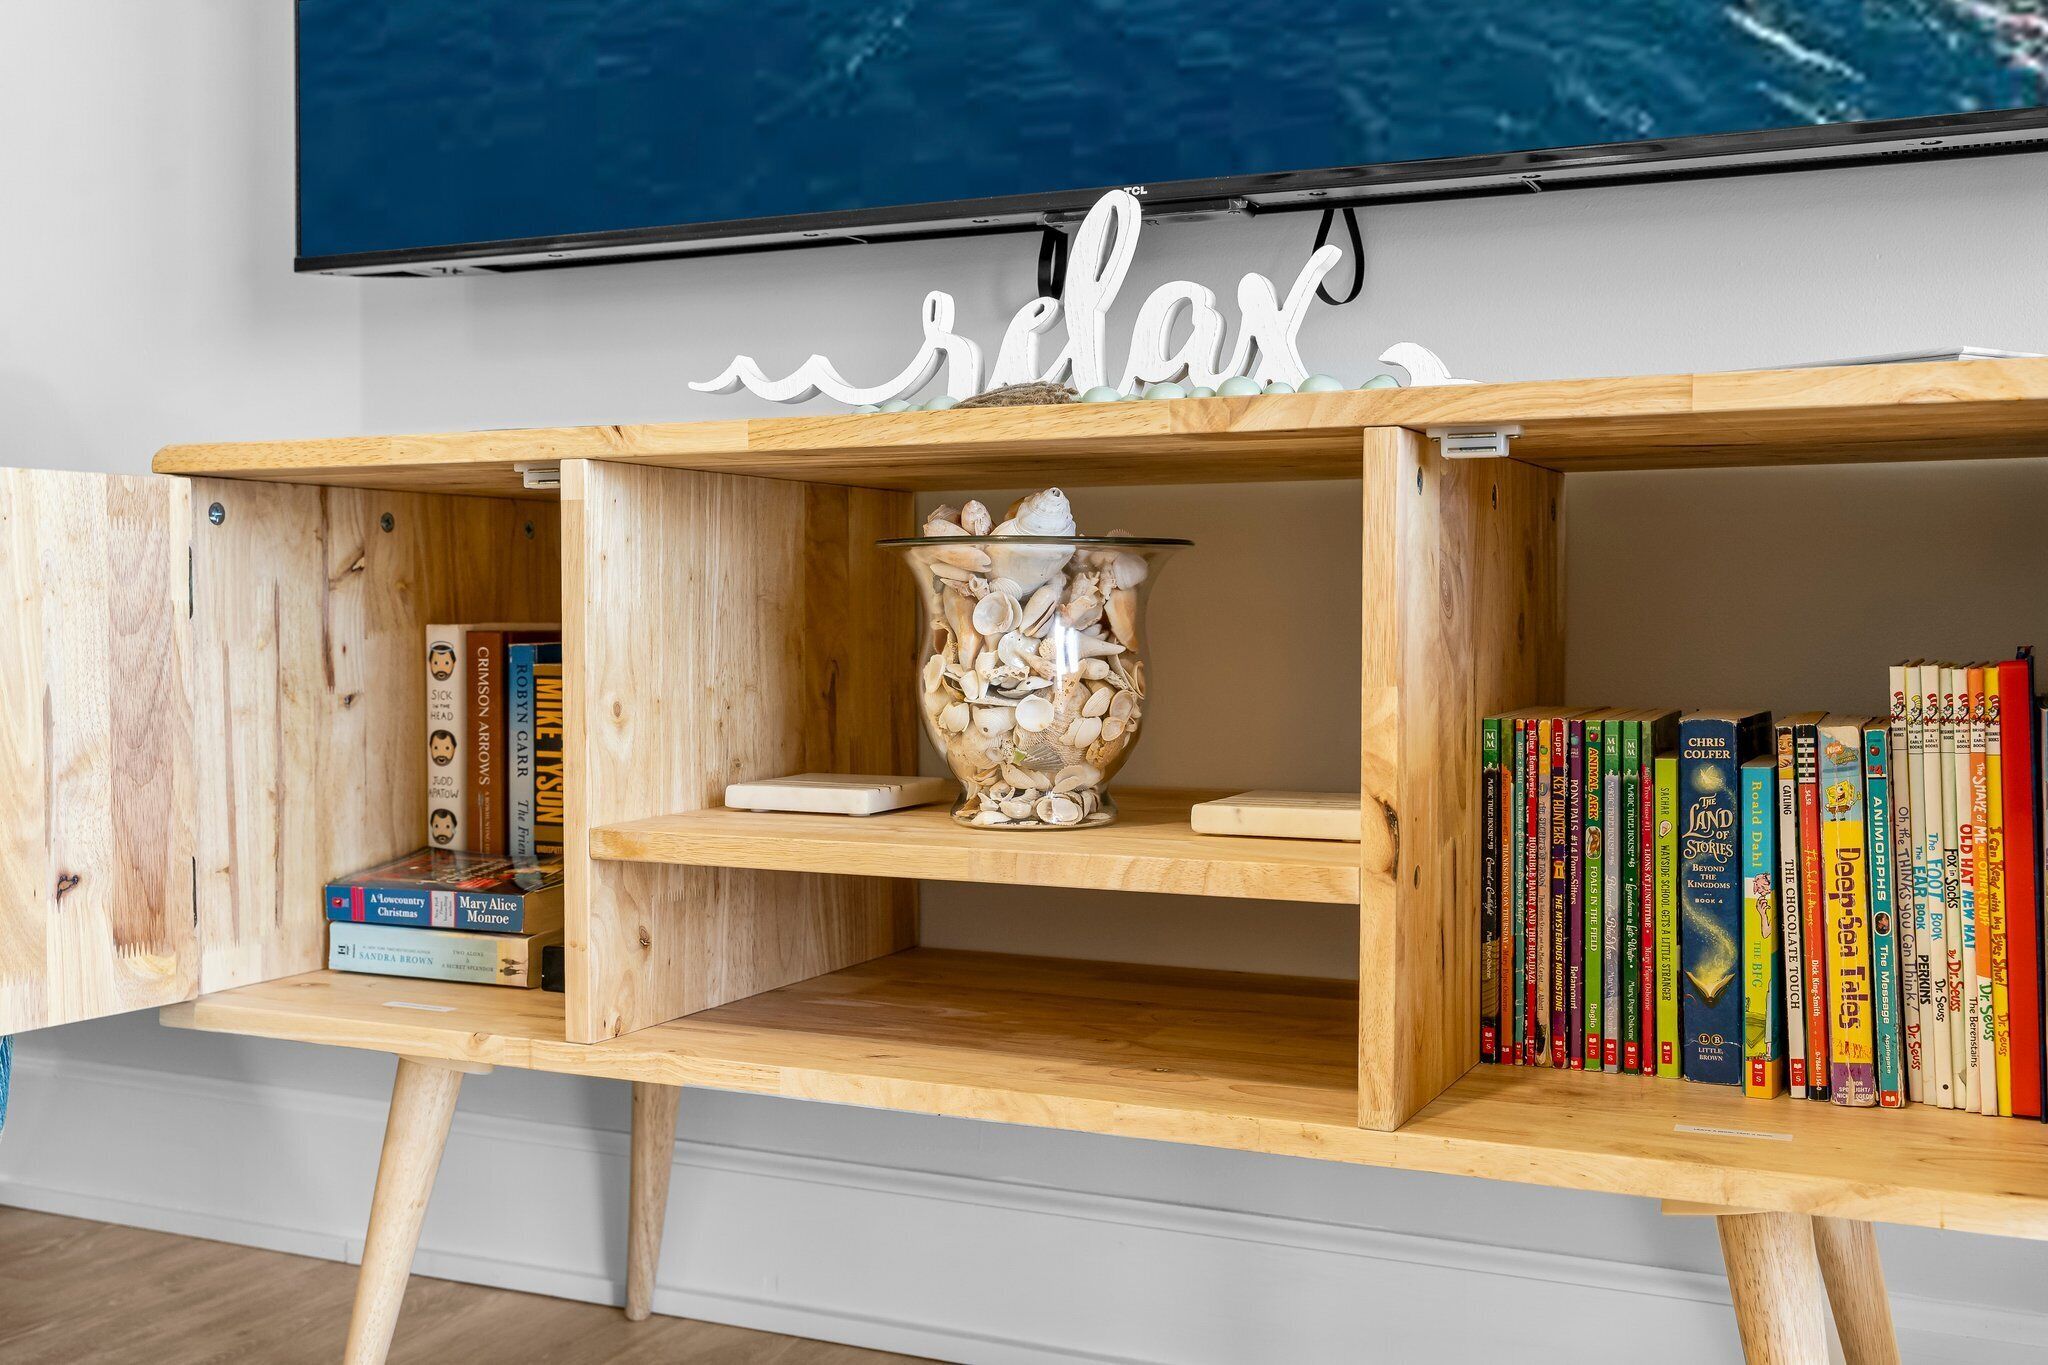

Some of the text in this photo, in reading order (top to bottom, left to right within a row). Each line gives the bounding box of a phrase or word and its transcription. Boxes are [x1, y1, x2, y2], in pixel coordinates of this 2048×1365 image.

[1124, 186, 1148, 196] TCL
[800, 188, 1343, 405] relax
[431, 689, 453, 700] SICK
[536, 679, 563, 740] MIKE
[431, 711, 454, 720] HEAD
[477, 647, 490, 785] CRIMSON ARROWS
[516, 664, 528, 778] ROBYN CARR
[1528, 730, 1536, 749] Kline
[1554, 732, 1563, 756] Luper
[1684, 750, 1730, 758] COLFER
[1689, 738, 1725, 746] CHRIS
[1588, 747, 1599, 819] ANIMAL ARK
[1976, 763, 1985, 775] The
[429, 788, 459, 798] APATOW
[536, 750, 563, 823] TYSON
[1661, 788, 1670, 815] SACHAR
[1783, 785, 1792, 815] CATLING
[1972, 776, 1987, 813] SHAPE
[517, 800, 529, 821] The
[1553, 776, 1565, 845] KEY HUNTERS
[1682, 804, 1734, 838] LAND
[1751, 781, 1762, 867] Roald Dahl
[1976, 814, 1986, 823] of
[1570, 779, 1578, 905] PONY PALS #14 Pony-Sitters
[1716, 830, 1729, 839] OF
[1873, 796, 1886, 901] ANIMORPHS
[1974, 825, 1987, 844] ME
[1661, 845, 1670, 877] WAYSIDE
[1683, 840, 1733, 863] STORIES
[1644, 873, 1651, 882] AT
[1913, 865, 1927, 898] EAR
[1926, 833, 1945, 941] The FOOT BOOK
[1960, 824, 1975, 948] OLD HAT NEW HAT
[1978, 861, 1988, 894] OTHER
[371, 894, 425, 908] A Lowcountry
[460, 896, 488, 913] Mary
[489, 898, 517, 911] Alice
[1503, 897, 1509, 906] ON
[1590, 896, 1597, 905] IN
[1661, 880, 1670, 908] SCHOOL
[1829, 848, 1862, 957] Deep-Sea
[1896, 806, 1919, 1012] Oh, the THINKS you Can Think!
[1989, 827, 2008, 987] I Can Read with My Eyes Shut!
[378, 907, 418, 918] Christmas
[467, 910, 509, 924] Monroe
[1528, 908, 1536, 924] AND
[1661, 910, 1671, 927] GETS
[1915, 903, 1926, 930] BOOK
[1979, 897, 1989, 926] STUFF
[1528, 927, 1536, 942] THE
[1661, 937, 1671, 961] LITTLE
[1785, 859, 1800, 1009] THE CHOCOLATE TOUCH
[360, 952, 433, 965] SANDRA BROWN
[1528, 945, 1536, 984] HOLIDAZE
[1555, 895, 1563, 1011] THE MYSTERIOUS MOONSTONE
[1570, 966, 1578, 1009] Betancourt
[1661, 964, 1671, 1000] STRANGER
[1751, 963, 1762, 988] BFG
[1880, 945, 1891, 1024] The Message
[1918, 955, 1931, 1004] PERKINS
[1947, 950, 1964, 1012] By Dr. Seuss
[1811, 977, 1820, 1016] King-Smith
[1839, 966, 1868, 1029] Tales
[1935, 979, 1947, 1022] Dr. Seuss
[1979, 982, 1995, 1042] Dr. Seuss
[1589, 1003, 1597, 1028] Baglio
[1907, 1024, 1921, 1070] Dr. Seuss
[1969, 997, 1978, 1068] The Berenstains
[1997, 1013, 2009, 1056] Dr. Seuss
